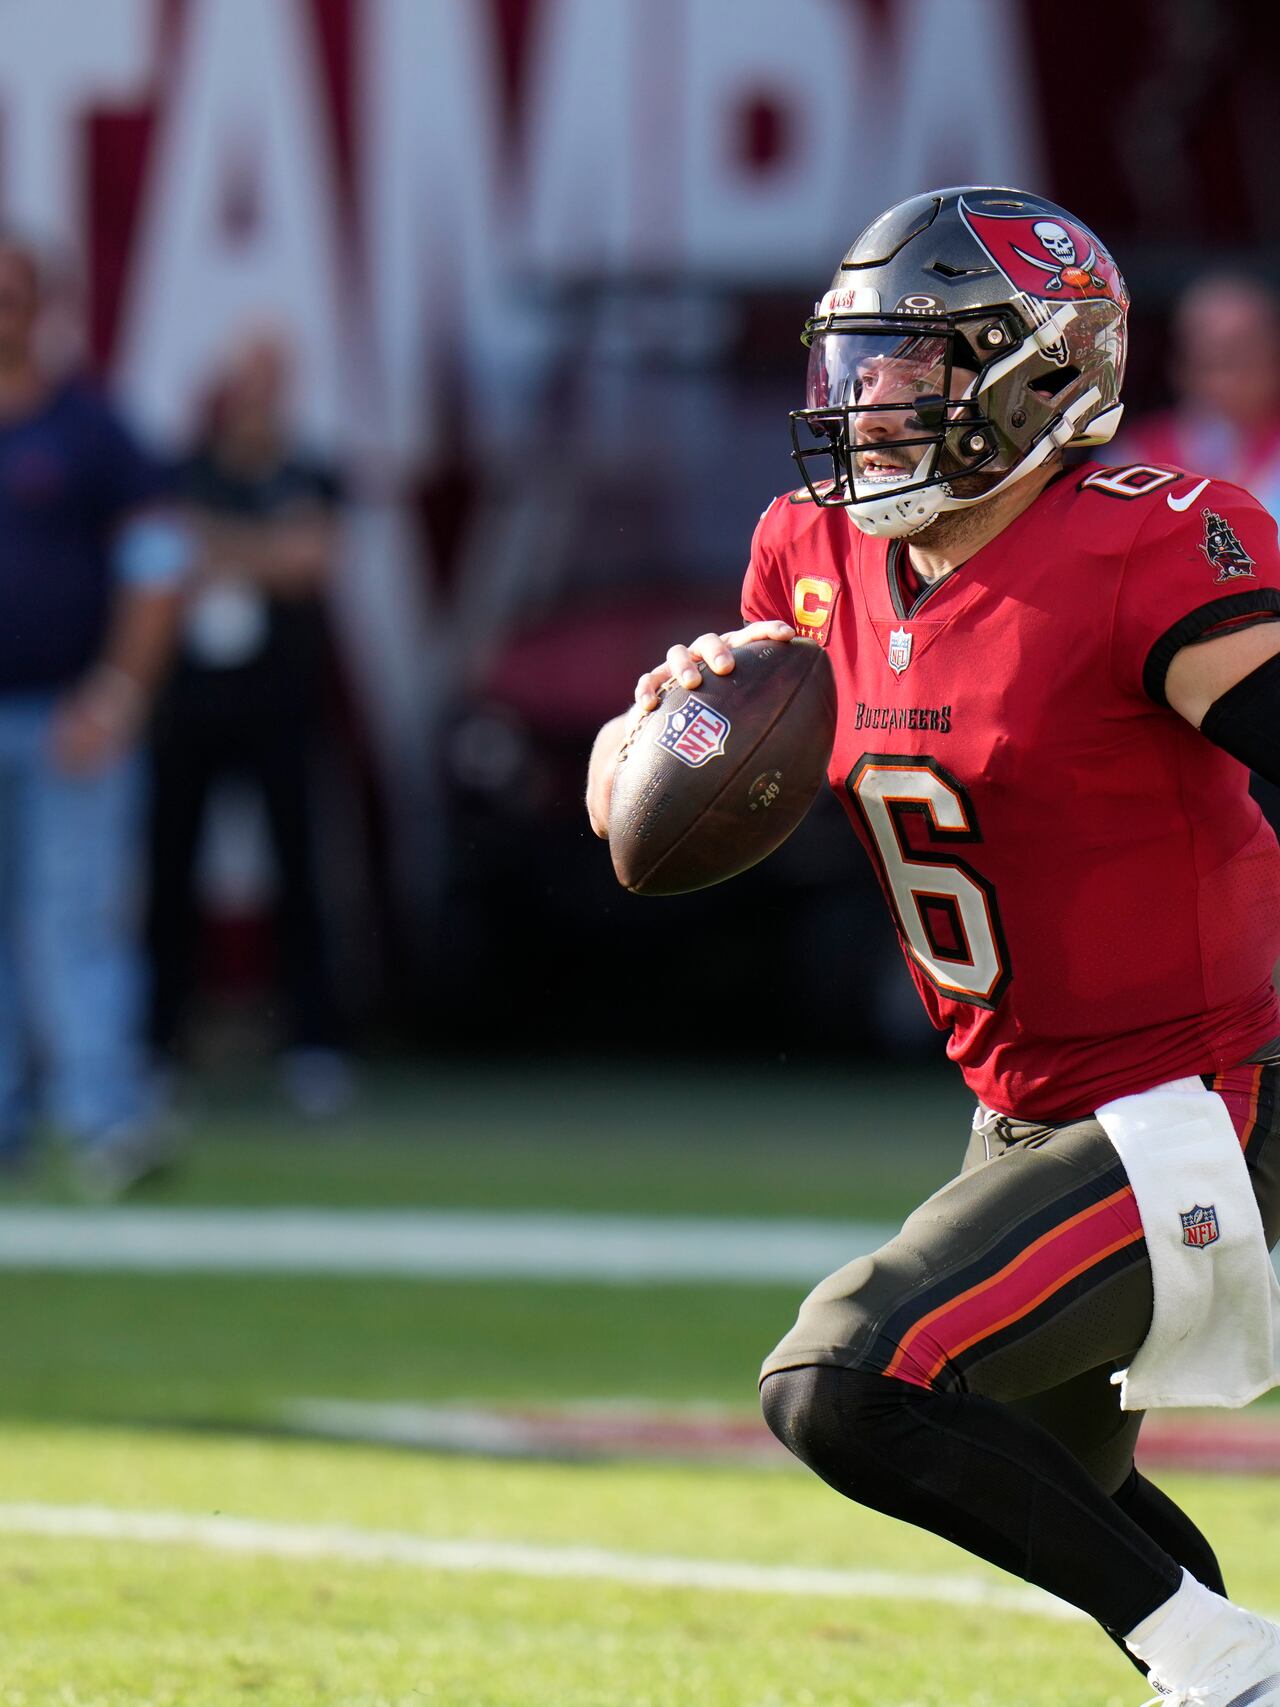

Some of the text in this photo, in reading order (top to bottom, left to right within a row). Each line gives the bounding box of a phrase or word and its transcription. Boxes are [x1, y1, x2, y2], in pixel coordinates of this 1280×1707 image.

[896, 307, 943, 316] OAKLEY
[1076, 463, 1185, 500] 6
[794, 580, 833, 628] C
[892, 648, 906, 666] NFL
[676, 715, 723, 760] NFL
[846, 753, 1013, 1011] 6
[1184, 1221, 1217, 1245] NFL
